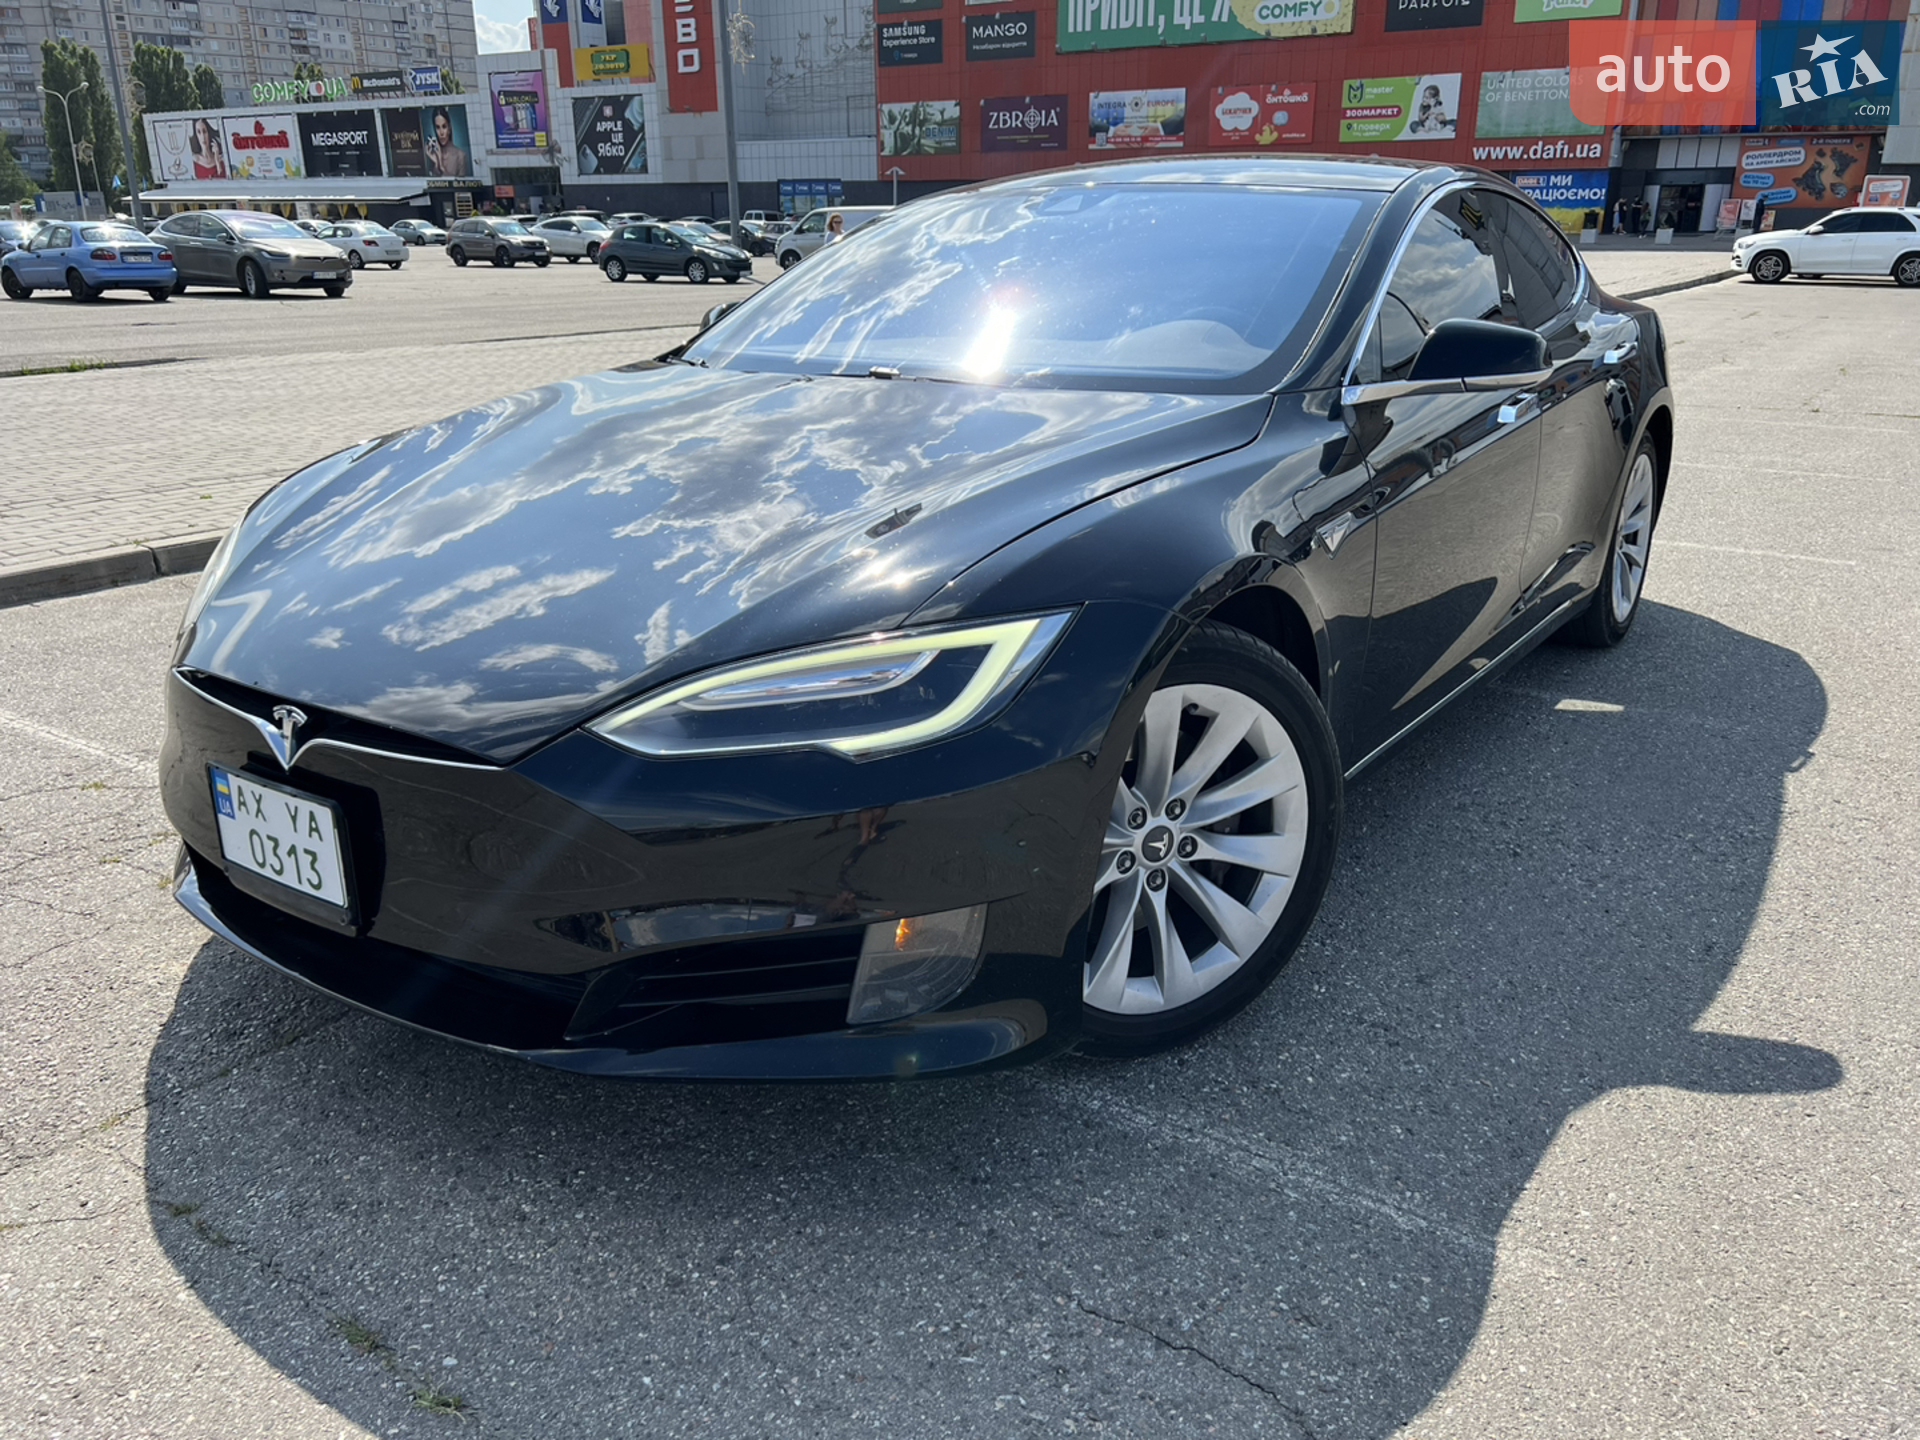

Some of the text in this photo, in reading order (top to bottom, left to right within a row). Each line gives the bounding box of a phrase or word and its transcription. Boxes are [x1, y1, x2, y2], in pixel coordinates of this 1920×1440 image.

[1258, 0, 1322, 20] COMFY
[882, 25, 926, 38] SAMSUNG
[972, 22, 1027, 39] MANGO
[882, 36, 936, 48] Experience Store
[362, 77, 401, 88] McDonald's
[415, 73, 439, 85] JYSK
[1487, 75, 1584, 89] UNITED COLORS
[250, 79, 309, 103] COMFY
[1365, 86, 1394, 94] master
[1485, 92, 1502, 103] OF
[1097, 99, 1176, 109] INTEGRA EUROPE
[1345, 107, 1399, 117] ЗООМАРКЕТ
[596, 121, 623, 132] APPLE
[925, 126, 957, 137] DENIM
[311, 130, 369, 147] MEGASPORT
[611, 133, 623, 143] ЦЕ
[597, 143, 625, 157] Ябко
[1472, 140, 1603, 160] www.dafi.ua
[1745, 150, 1802, 160] РОЛЛЕРДРОМ
[1549, 175, 1573, 186] МИ
[1522, 188, 1606, 202] РАЦЮЄМО!
[218, 797, 234, 817] UA
[237, 785, 323, 843] AX YA
[249, 828, 323, 891] 0313
